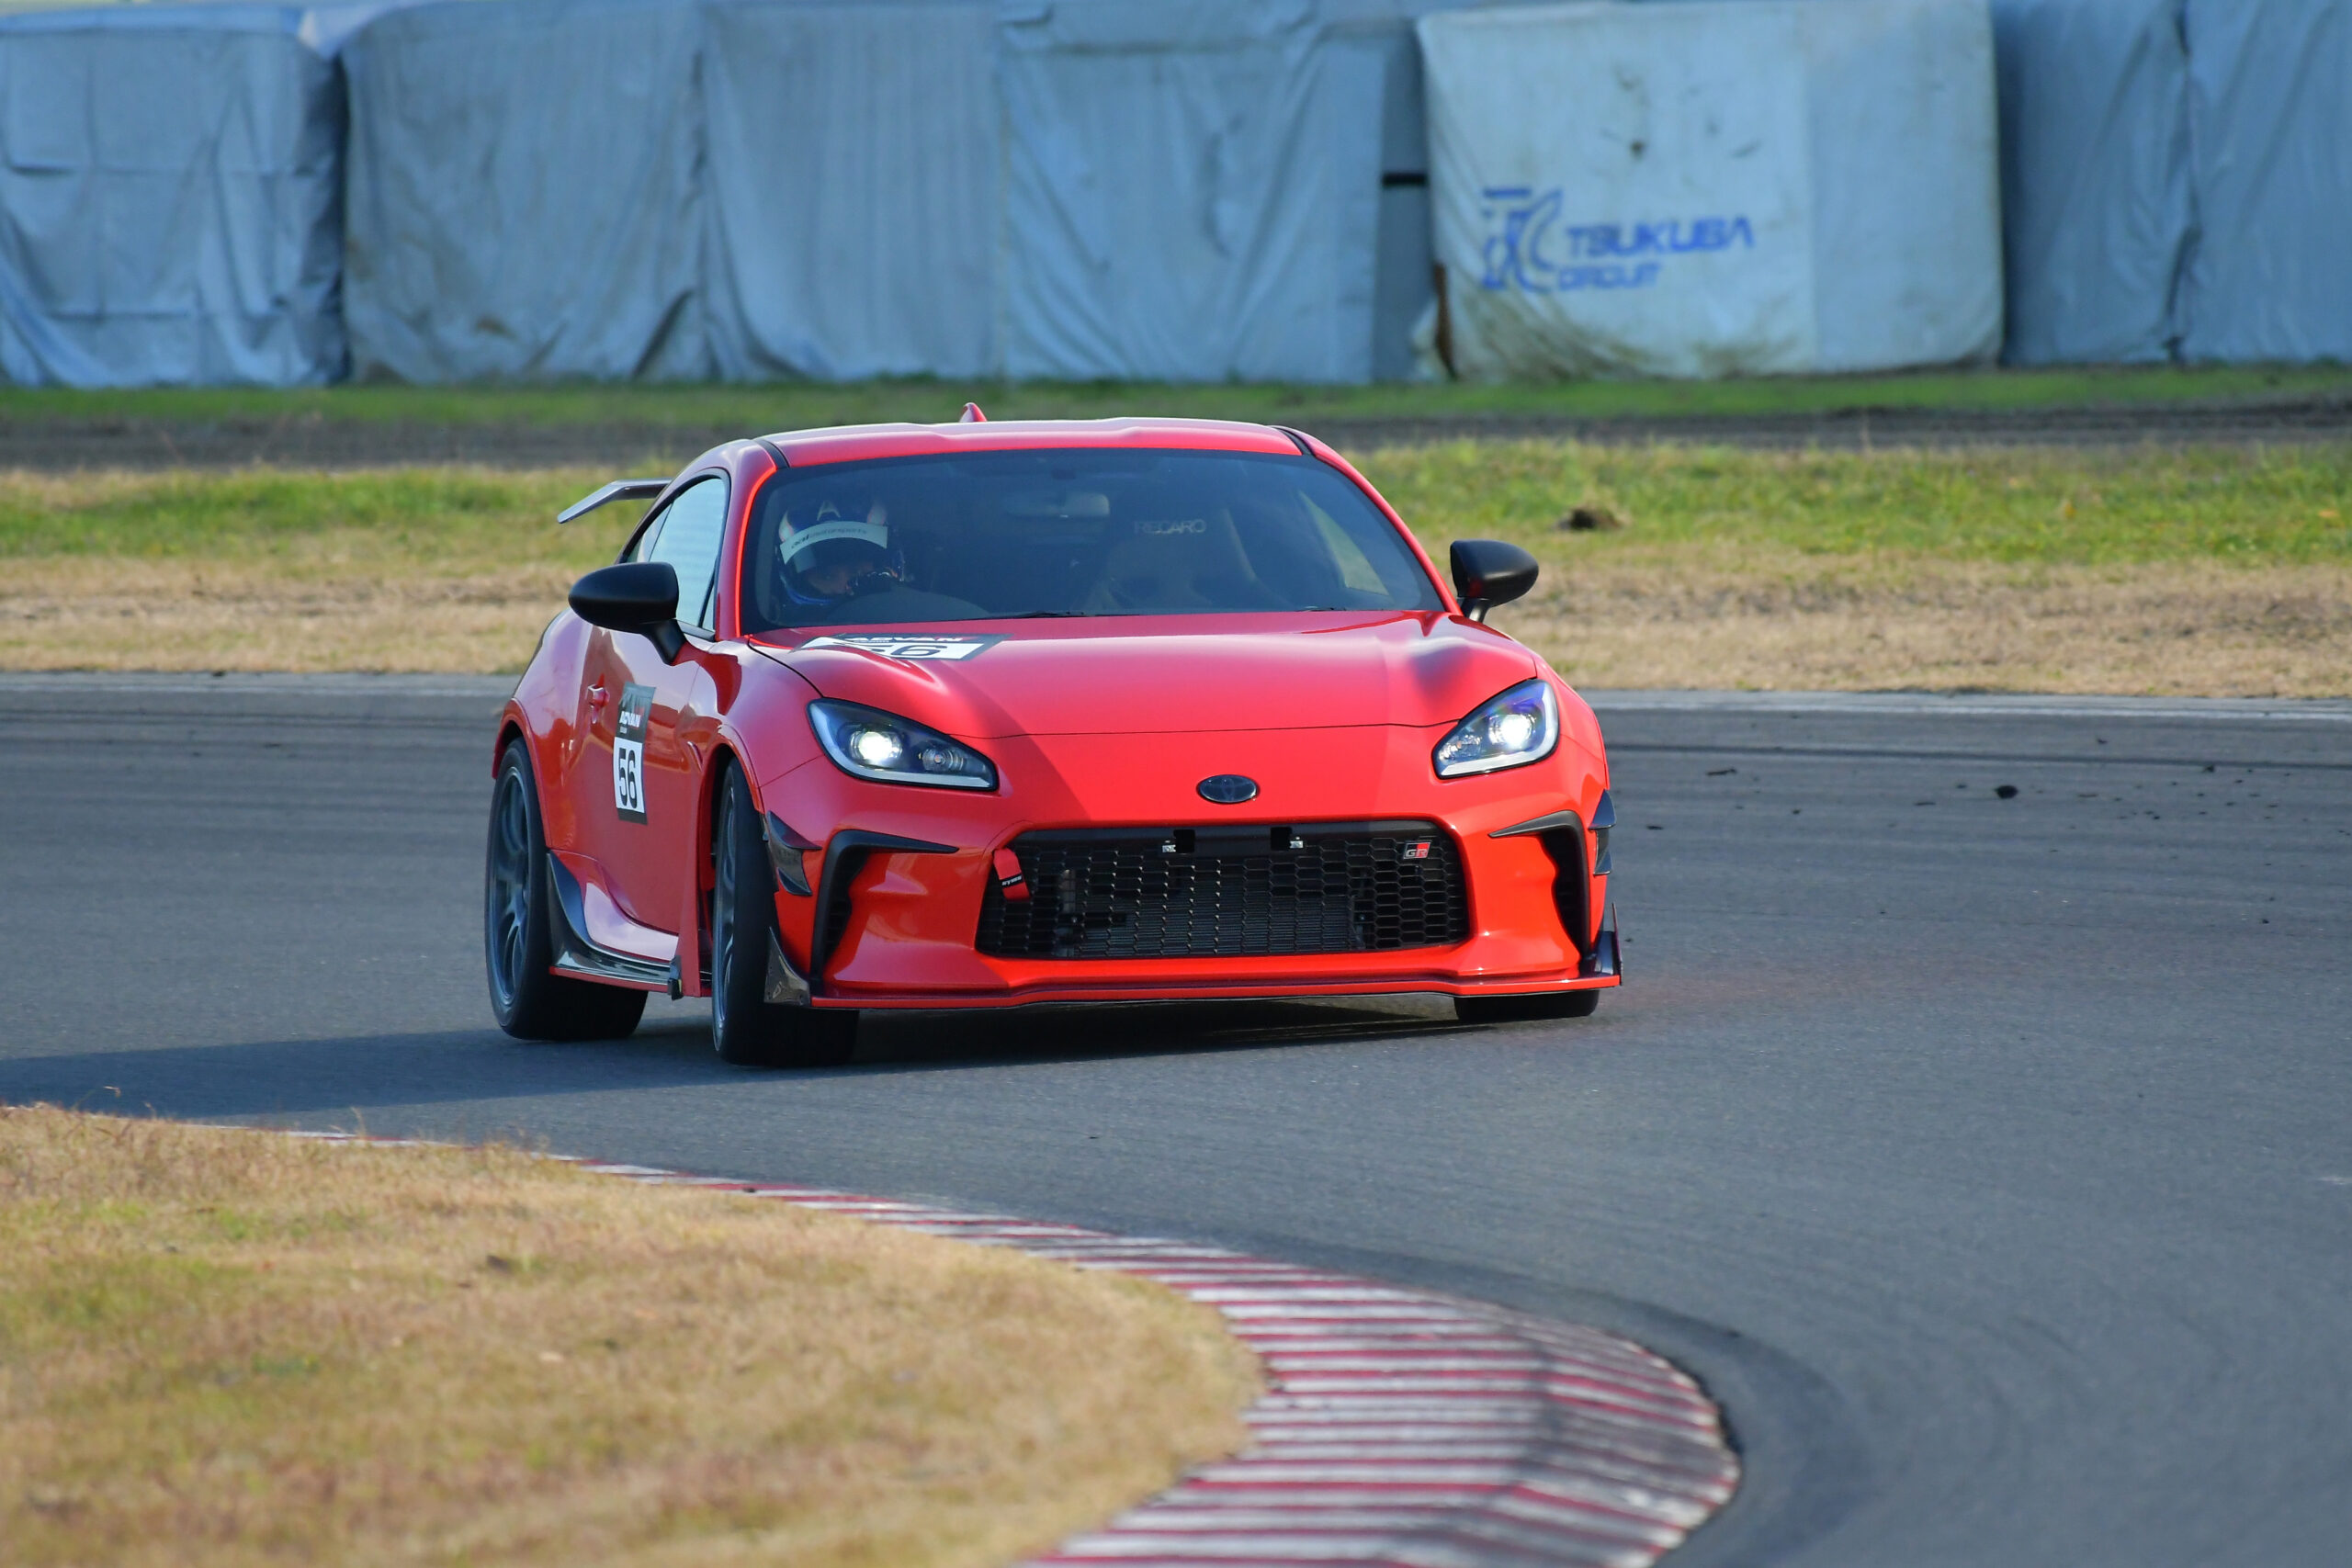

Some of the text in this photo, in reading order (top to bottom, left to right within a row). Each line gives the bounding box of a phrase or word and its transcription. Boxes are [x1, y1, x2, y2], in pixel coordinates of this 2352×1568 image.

[1565, 215, 1754, 258] TSUKUBA
[1134, 519, 1207, 535] RECARO
[618, 747, 638, 809] 56
